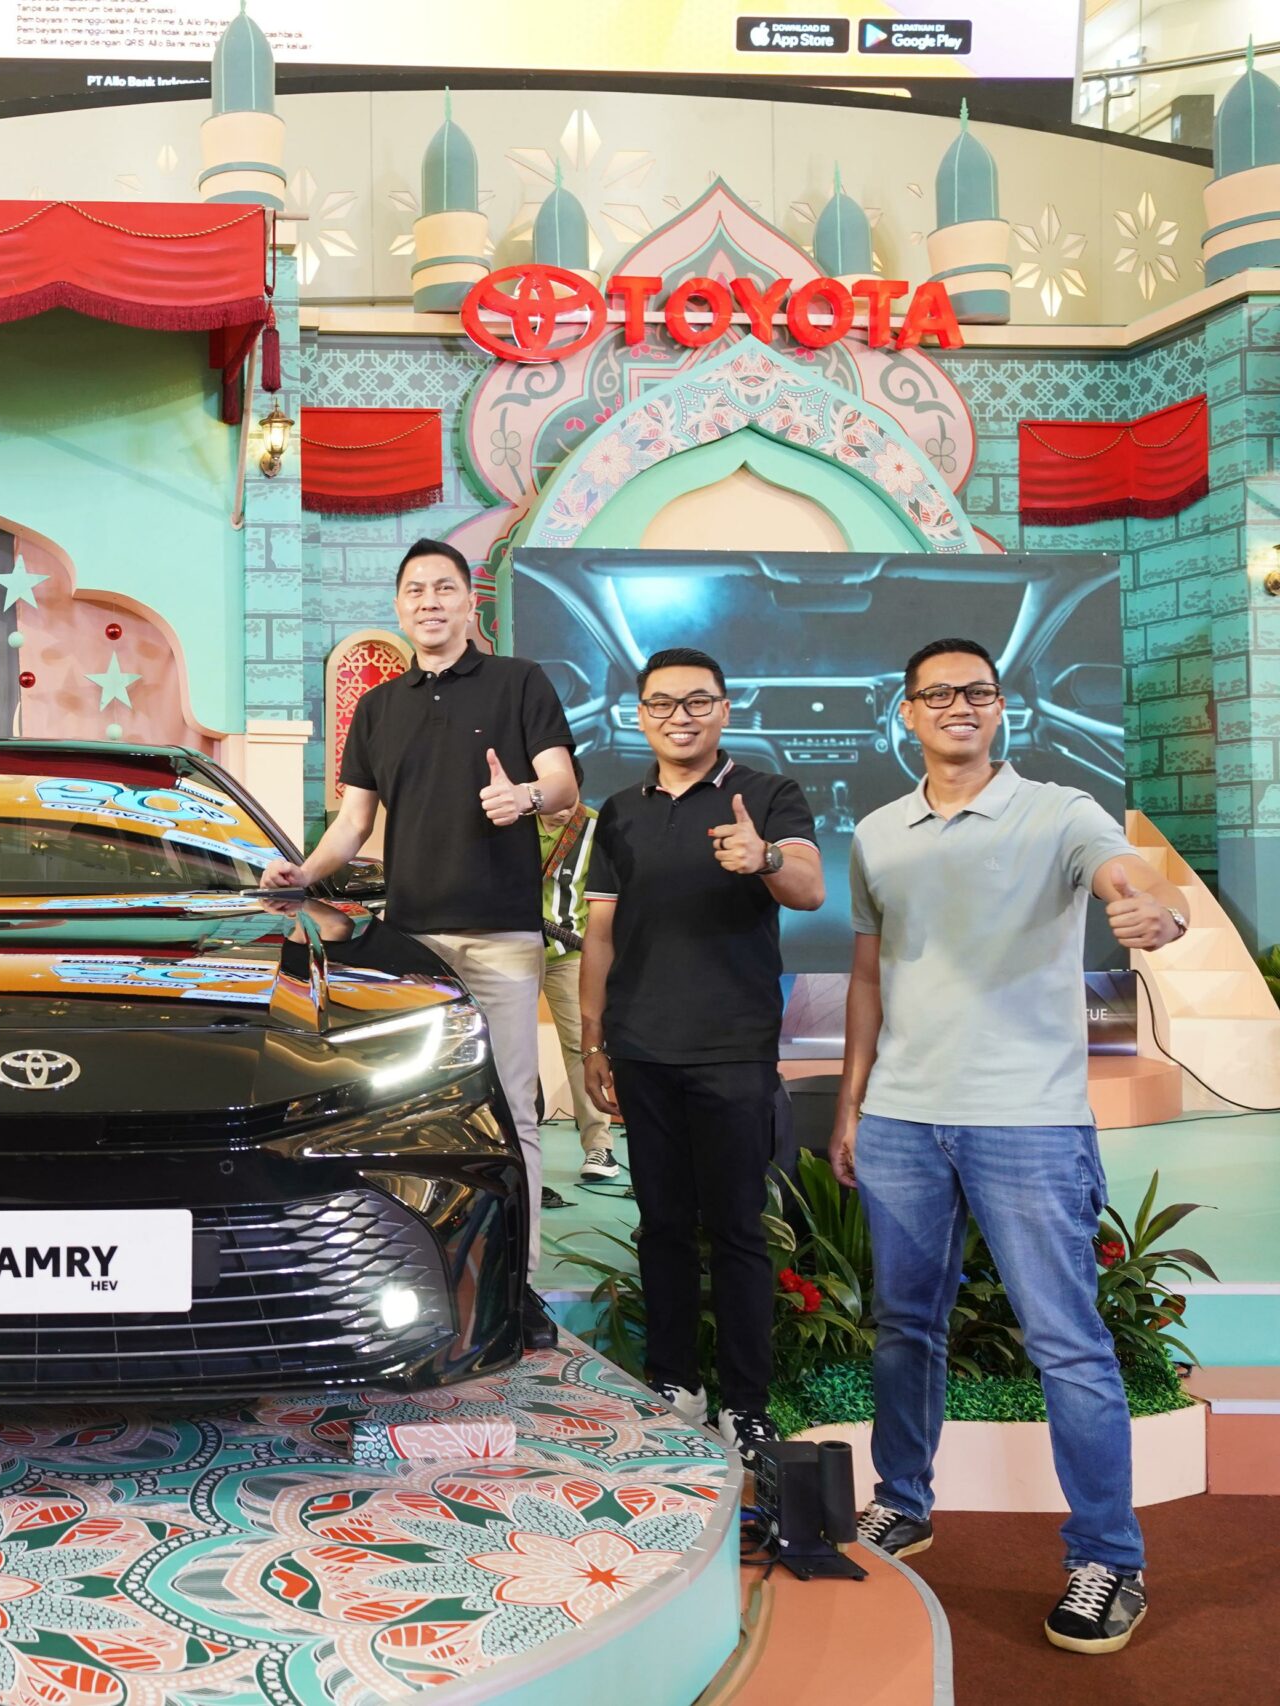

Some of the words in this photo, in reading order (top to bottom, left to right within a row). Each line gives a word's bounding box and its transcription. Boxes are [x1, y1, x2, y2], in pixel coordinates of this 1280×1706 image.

[772, 23, 818, 33] DOWNLOAD
[820, 24, 830, 33] DI
[935, 24, 946, 33] DI
[772, 33, 798, 48] App
[800, 33, 835, 48] Store
[891, 33, 936, 51] Google
[936, 33, 963, 51] Play
[87, 75, 103, 86] PT
[104, 75, 127, 87] Allo
[127, 75, 156, 87] Bank
[606, 275, 965, 350] TOYOTA
[91, 1280, 118, 1291] HEV
